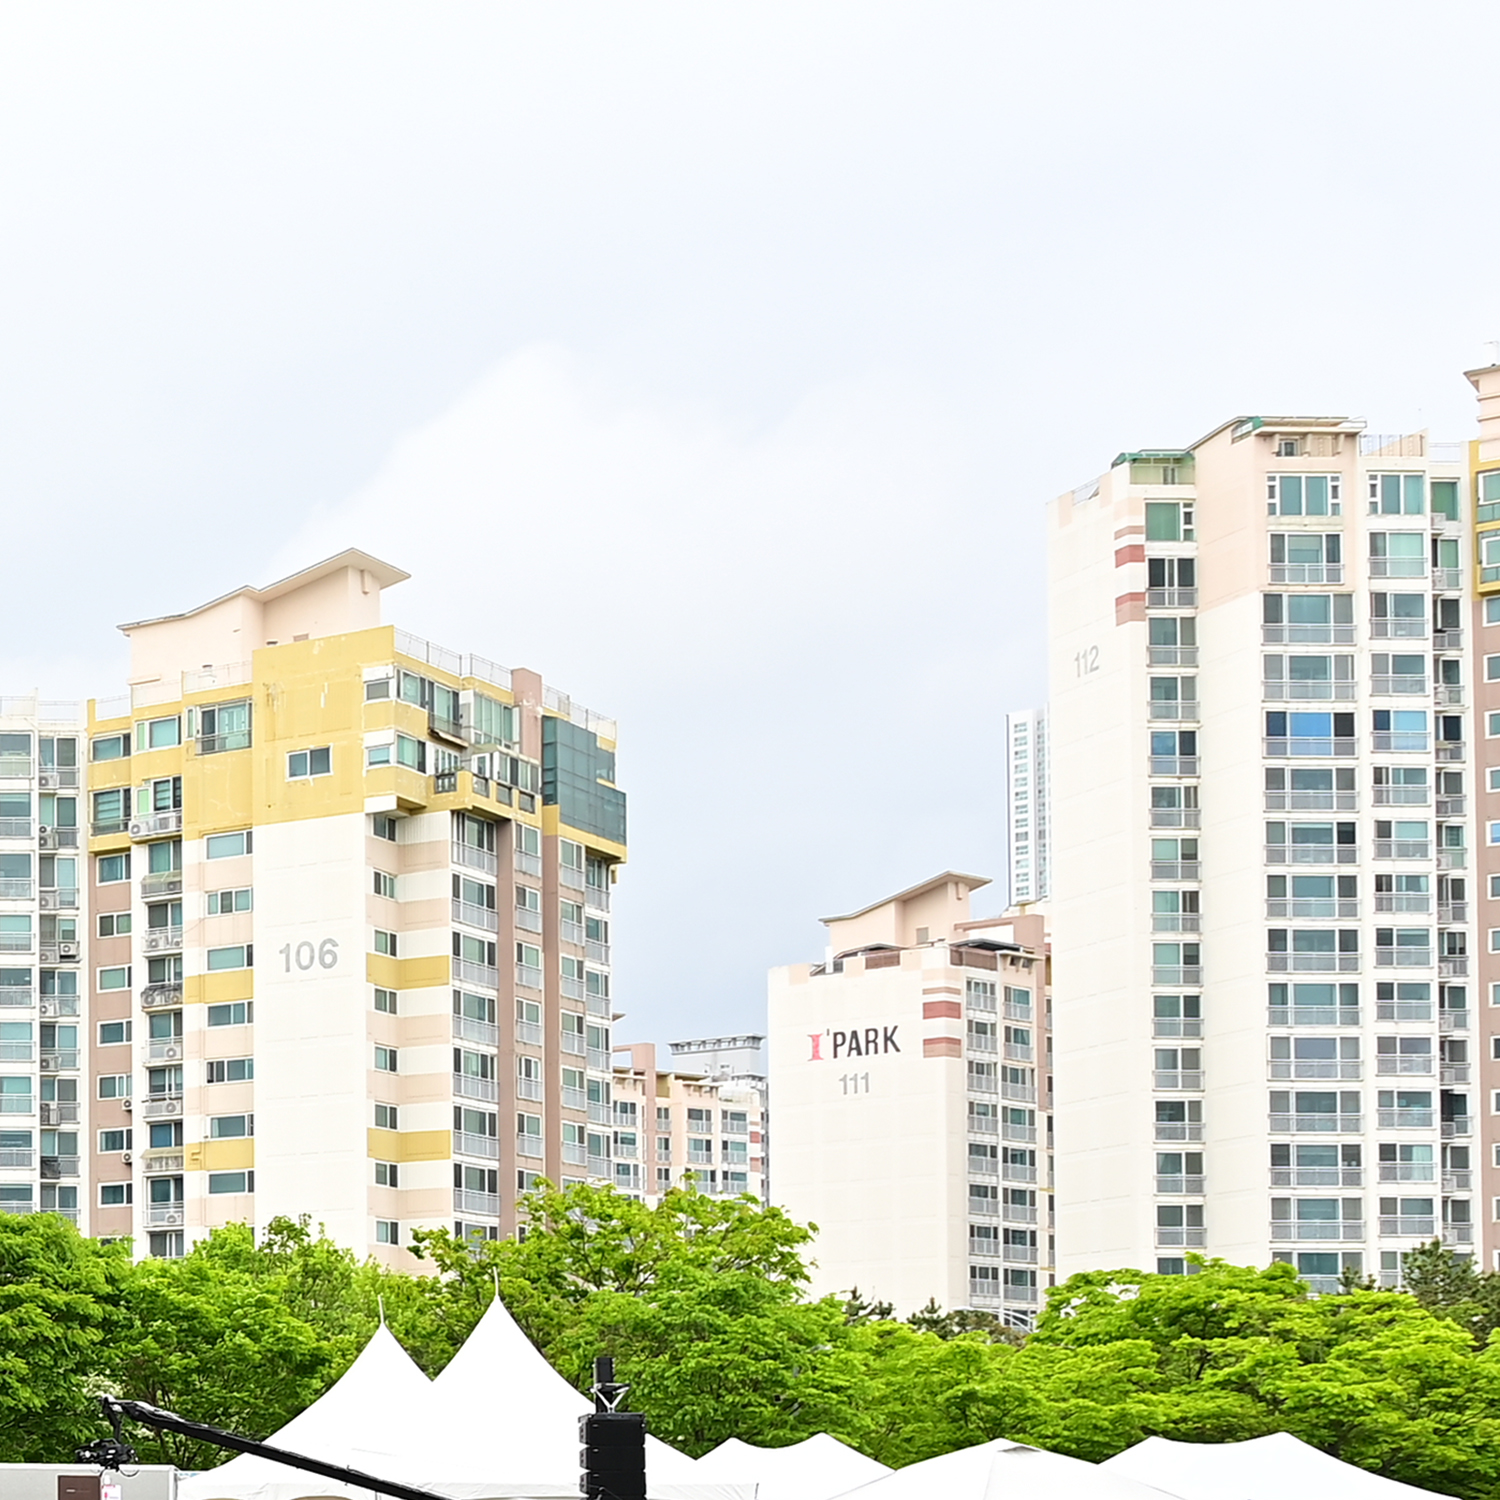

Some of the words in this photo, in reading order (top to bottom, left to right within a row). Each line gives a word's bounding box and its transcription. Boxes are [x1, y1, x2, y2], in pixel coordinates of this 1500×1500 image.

[1074, 645, 1100, 678] 112
[279, 938, 339, 973] 106
[807, 1025, 901, 1061] I'PARK
[838, 1072, 869, 1095] 111
